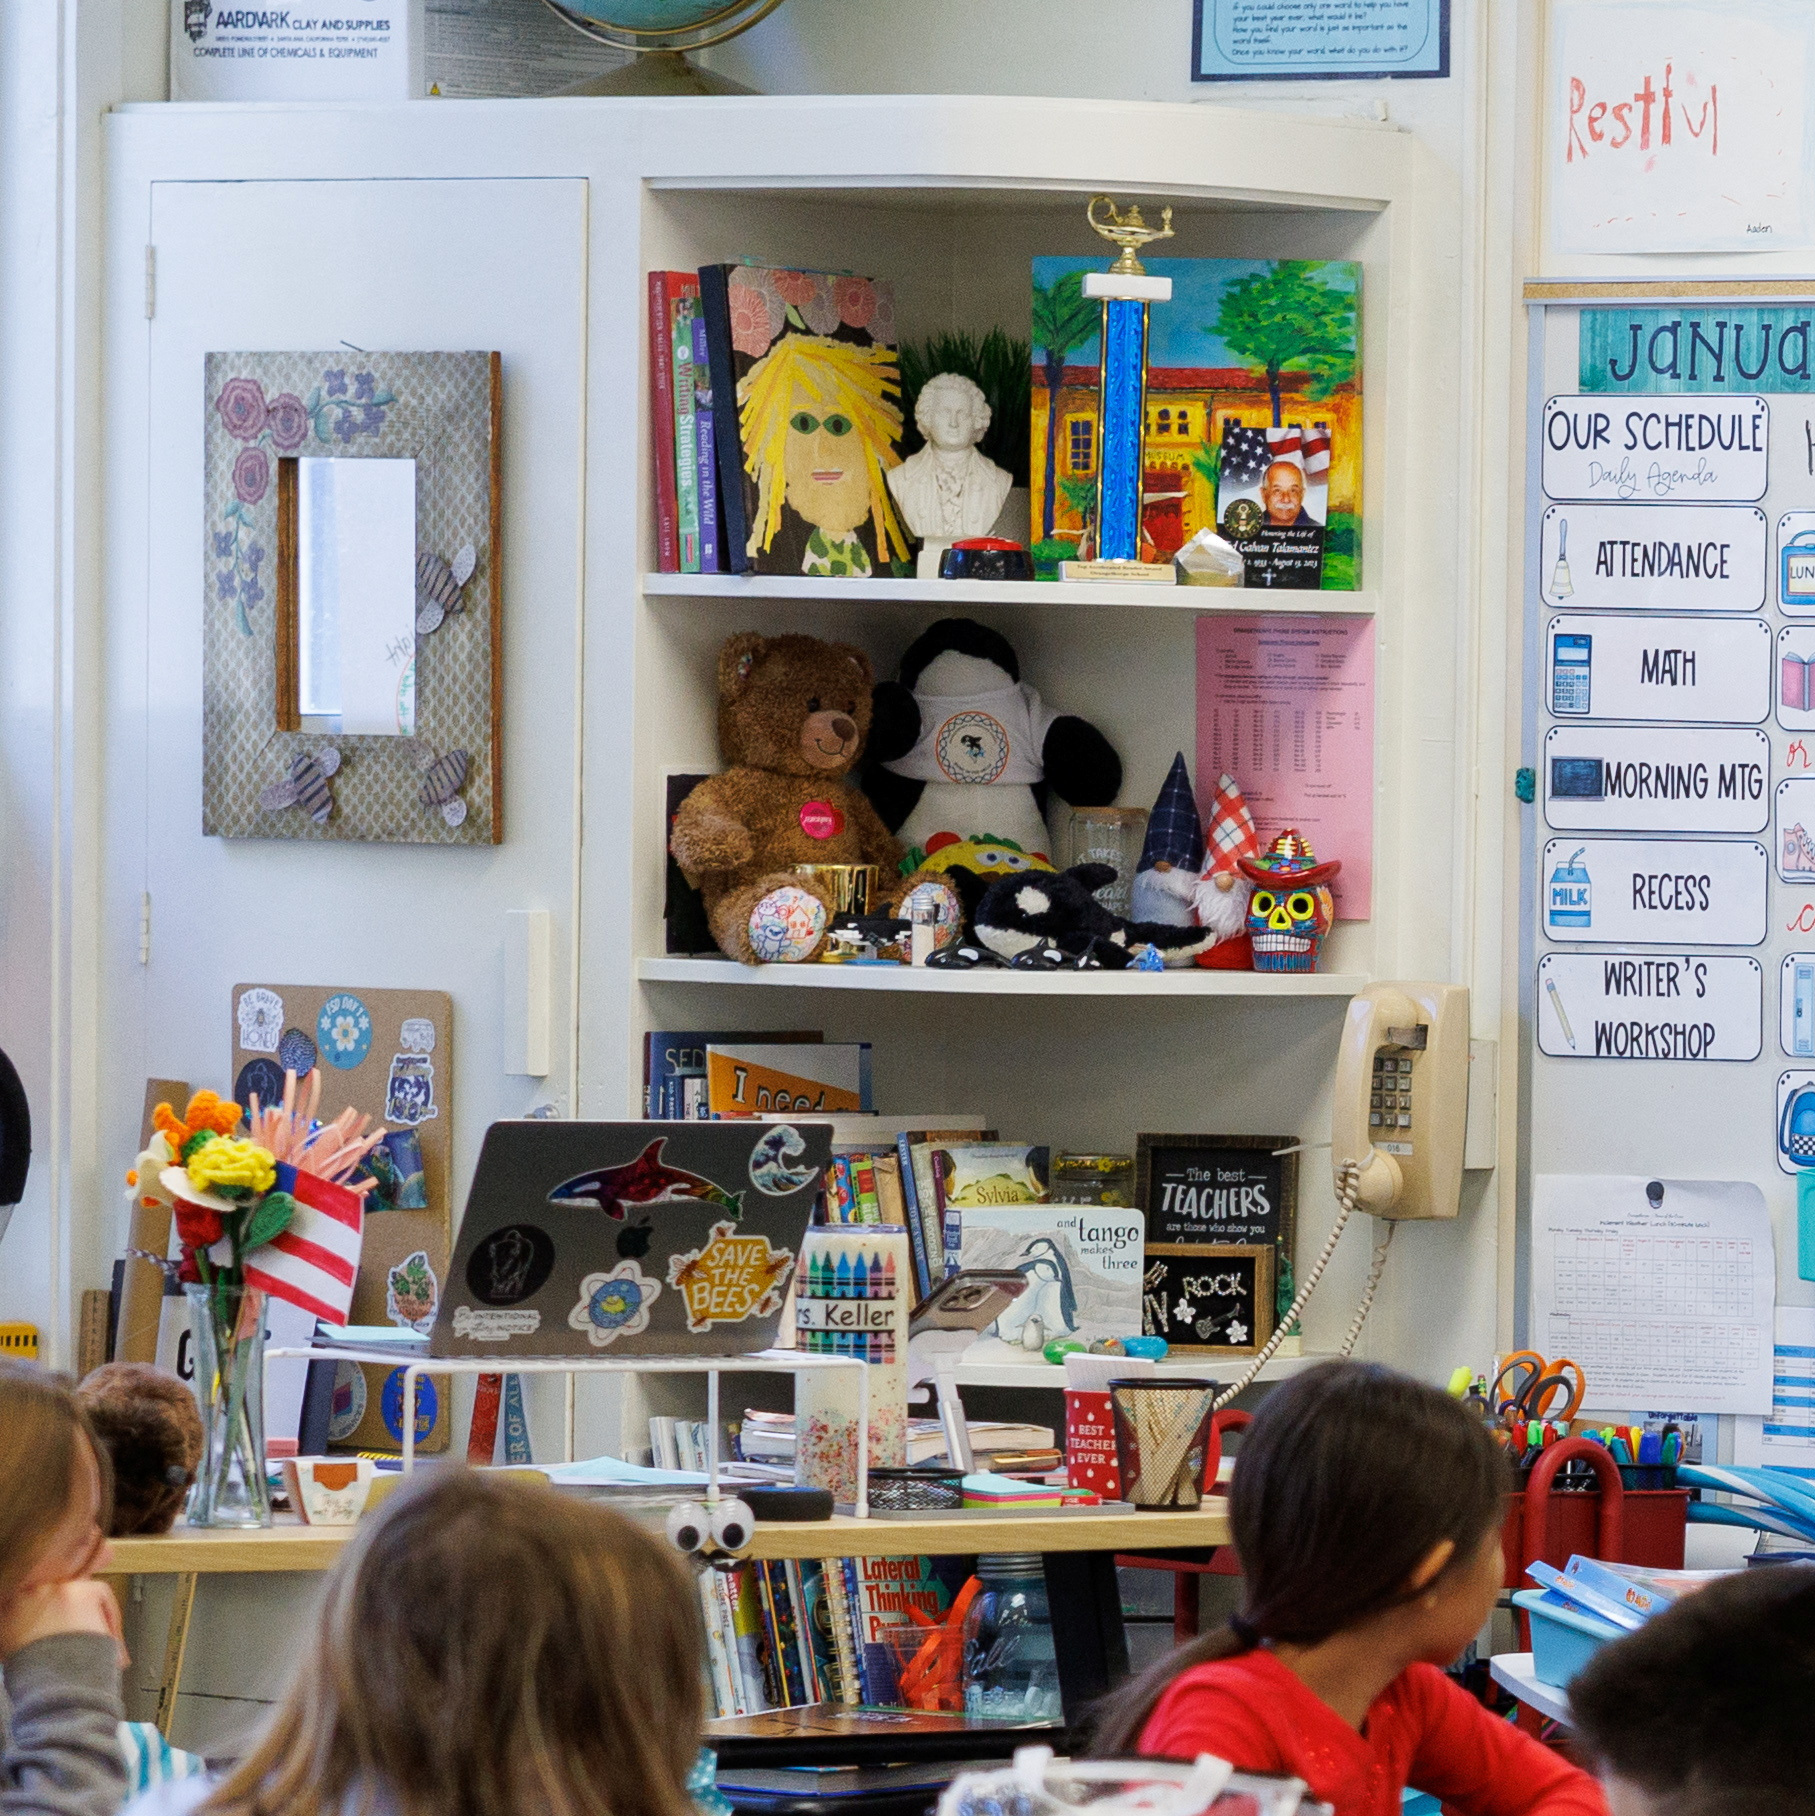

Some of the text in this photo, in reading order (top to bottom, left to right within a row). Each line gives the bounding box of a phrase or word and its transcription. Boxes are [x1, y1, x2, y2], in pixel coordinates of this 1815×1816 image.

[216, 11, 391, 31] AARDVARK CLAY AND SUPPLIES
[1566, 60, 1721, 164] Restful
[1548, 412, 1763, 452] OUR SCHEDULE
[680, 413, 695, 488] Strategies
[700, 420, 714, 525] Reading Wild
[1595, 541, 1731, 579] ATTENDANCE
[1641, 648, 1696, 686] MATH
[1786, 740, 1812, 770] or
[1604, 762, 1763, 800] MORNING MTG
[1551, 888, 1589, 905] MILK
[1631, 874, 1711, 911] RECESS
[1604, 959, 1708, 998] WRITER'S
[1594, 1022, 1716, 1058] WORKSHOP
[733, 1066, 748, 1104] I
[1186, 1167, 1246, 1182] The best
[976, 1186, 1019, 1204] Sylvia
[1162, 1183, 1271, 1219] TEACHERS
[1057, 1216, 1139, 1250] and tango
[1166, 1223, 1181, 1231] are
[1250, 1225, 1265, 1235] you
[707, 1242, 764, 1267] SAVE
[1080, 1244, 1114, 1255] makes
[1102, 1256, 1138, 1270] three
[712, 1267, 750, 1285] THE
[1183, 1273, 1247, 1299] ROCK
[692, 1283, 759, 1314] BEES
[825, 1303, 895, 1327] Keller
[1079, 1424, 1105, 1436] BEST
[1077, 1453, 1106, 1464] EVER
[862, 1556, 921, 1581] Lateral
[865, 1584, 939, 1614] Thinking
